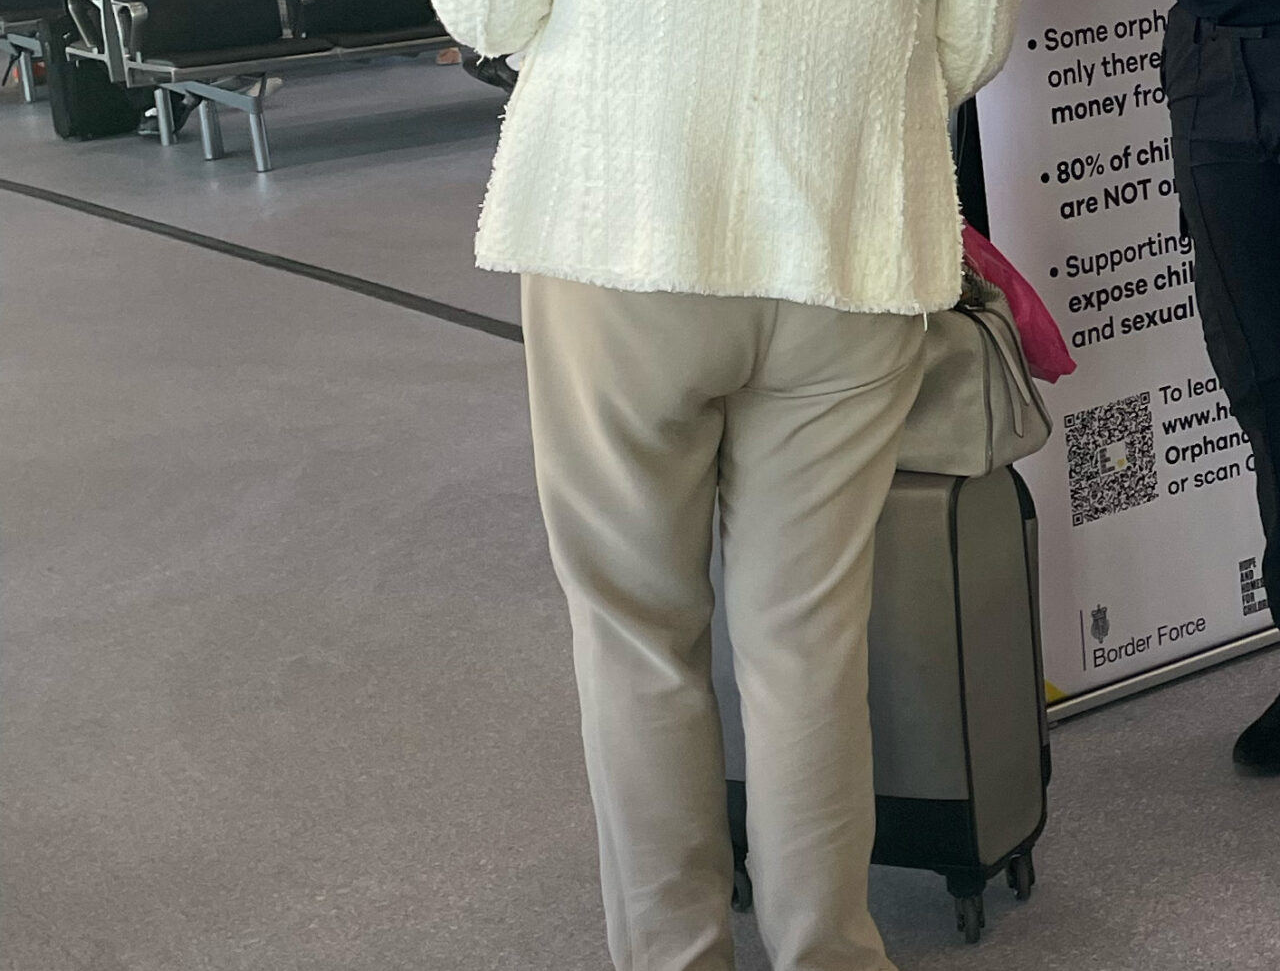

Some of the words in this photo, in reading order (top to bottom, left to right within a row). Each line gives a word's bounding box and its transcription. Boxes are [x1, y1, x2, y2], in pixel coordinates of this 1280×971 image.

[1044, 25, 1108, 52] Some
[1048, 59, 1095, 88] only
[1101, 52, 1161, 77] there
[1051, 93, 1127, 124] money
[1056, 153, 1105, 184] 80%
[1110, 145, 1132, 171] of
[1060, 197, 1098, 219] are
[1104, 179, 1151, 209] NOT
[1065, 232, 1192, 278] Supporting
[1068, 279, 1148, 315] expose
[1072, 315, 1115, 348] and
[1120, 296, 1194, 334] sexual
[1159, 385, 1182, 404] To
[1187, 378, 1222, 398] lea
[1168, 477, 1188, 495] or
[1194, 463, 1240, 488] scan
[1093, 634, 1152, 668] Border
[1157, 617, 1206, 646] Force
